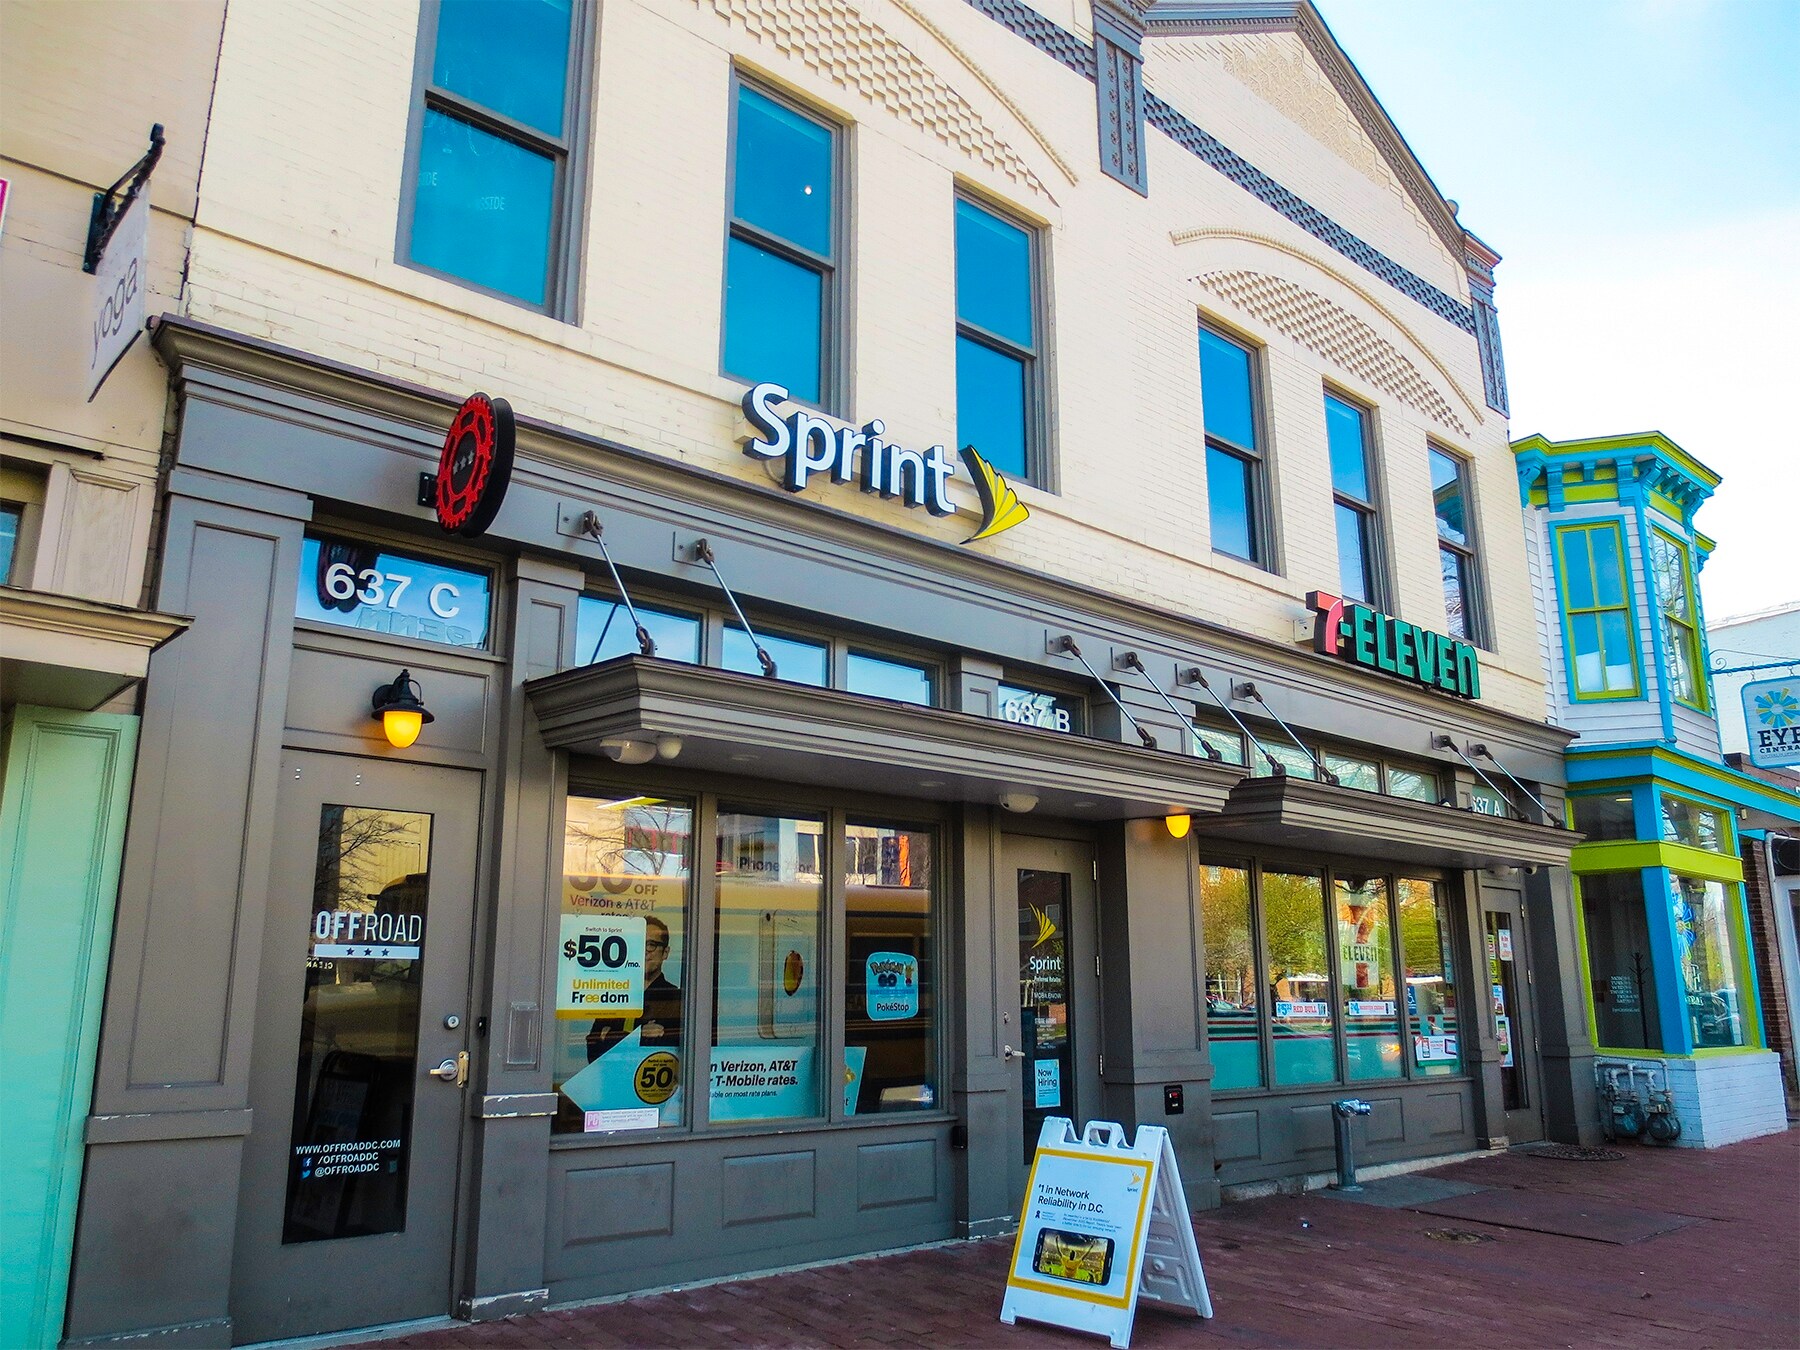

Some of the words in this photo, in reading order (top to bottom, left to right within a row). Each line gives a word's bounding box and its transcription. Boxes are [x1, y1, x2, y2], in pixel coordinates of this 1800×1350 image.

[91, 257, 138, 371] yoga
[742, 381, 957, 518] Sprint
[325, 563, 412, 609] 637
[429, 582, 460, 618] C
[1005, 697, 1046, 728] 637
[1055, 708, 1071, 733] B
[1494, 800, 1502, 817] A
[634, 884, 659, 896] OFF
[570, 894, 614, 909] Verizon
[615, 901, 623, 909] &
[625, 898, 657, 912] AT&T
[1029, 956, 1062, 974] Sprint
[572, 979, 630, 990] Unlimited
[571, 991, 629, 1003] Freedom
[876, 1002, 910, 1012] PokéStop
[720, 1060, 767, 1073] Verizon,
[768, 1060, 799, 1072] AT&T
[1037, 1068, 1053, 1077] Now
[640, 1066, 674, 1089] 50
[715, 1074, 766, 1087] T-Mobile
[767, 1074, 799, 1086] rates.
[1037, 1078, 1058, 1088] Hiring
[295, 1139, 401, 1155] WWW.OFFROADDC.COM
[317, 1152, 379, 1165] /OFFROADDC
[314, 1163, 380, 1178] @OFFROADDC
[1045, 1185, 1054, 1195] in
[1054, 1186, 1090, 1200] Network
[1037, 1195, 1078, 1211] Reliability
[1078, 1200, 1087, 1211] in
[1088, 1203, 1104, 1214] D.C.
